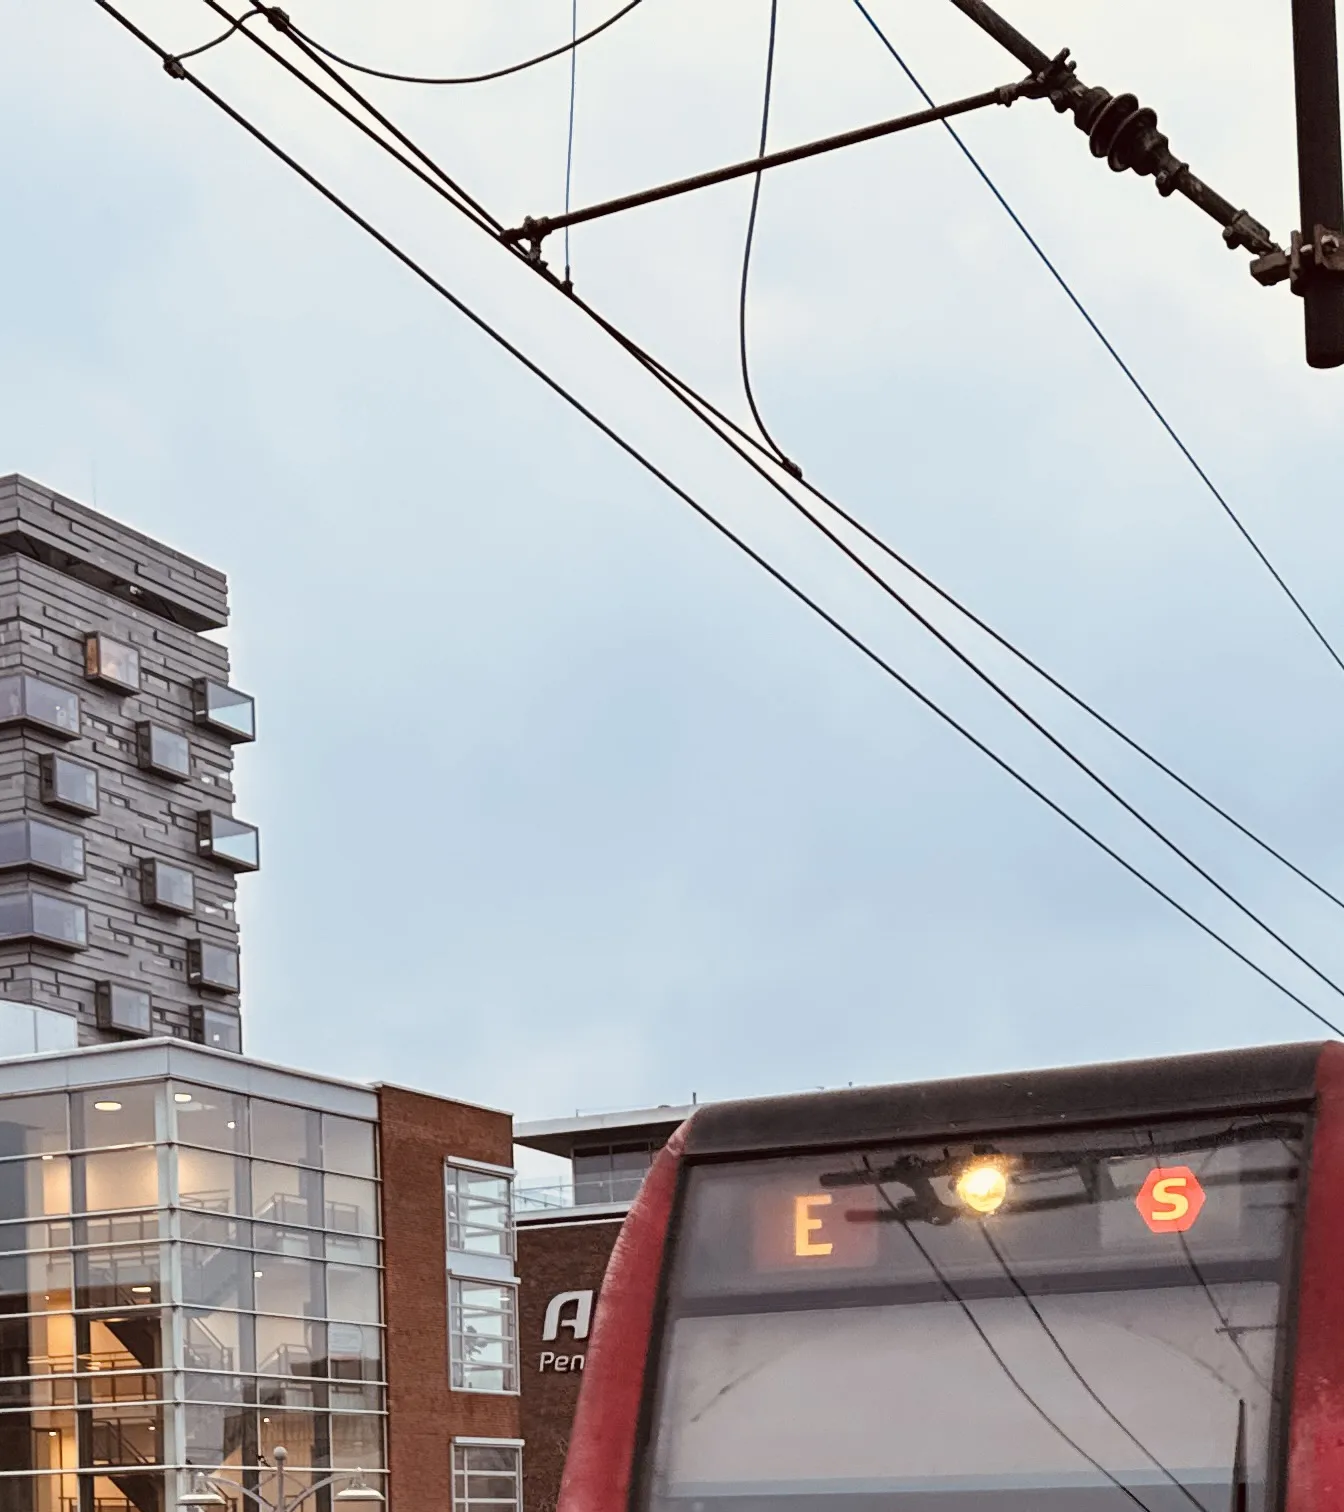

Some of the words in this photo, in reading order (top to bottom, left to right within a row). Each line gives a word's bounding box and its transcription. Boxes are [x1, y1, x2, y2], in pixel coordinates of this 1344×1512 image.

[1151, 1177, 1189, 1221] S
[794, 1194, 833, 1256] E
[538, 1351, 585, 1372] Pen
